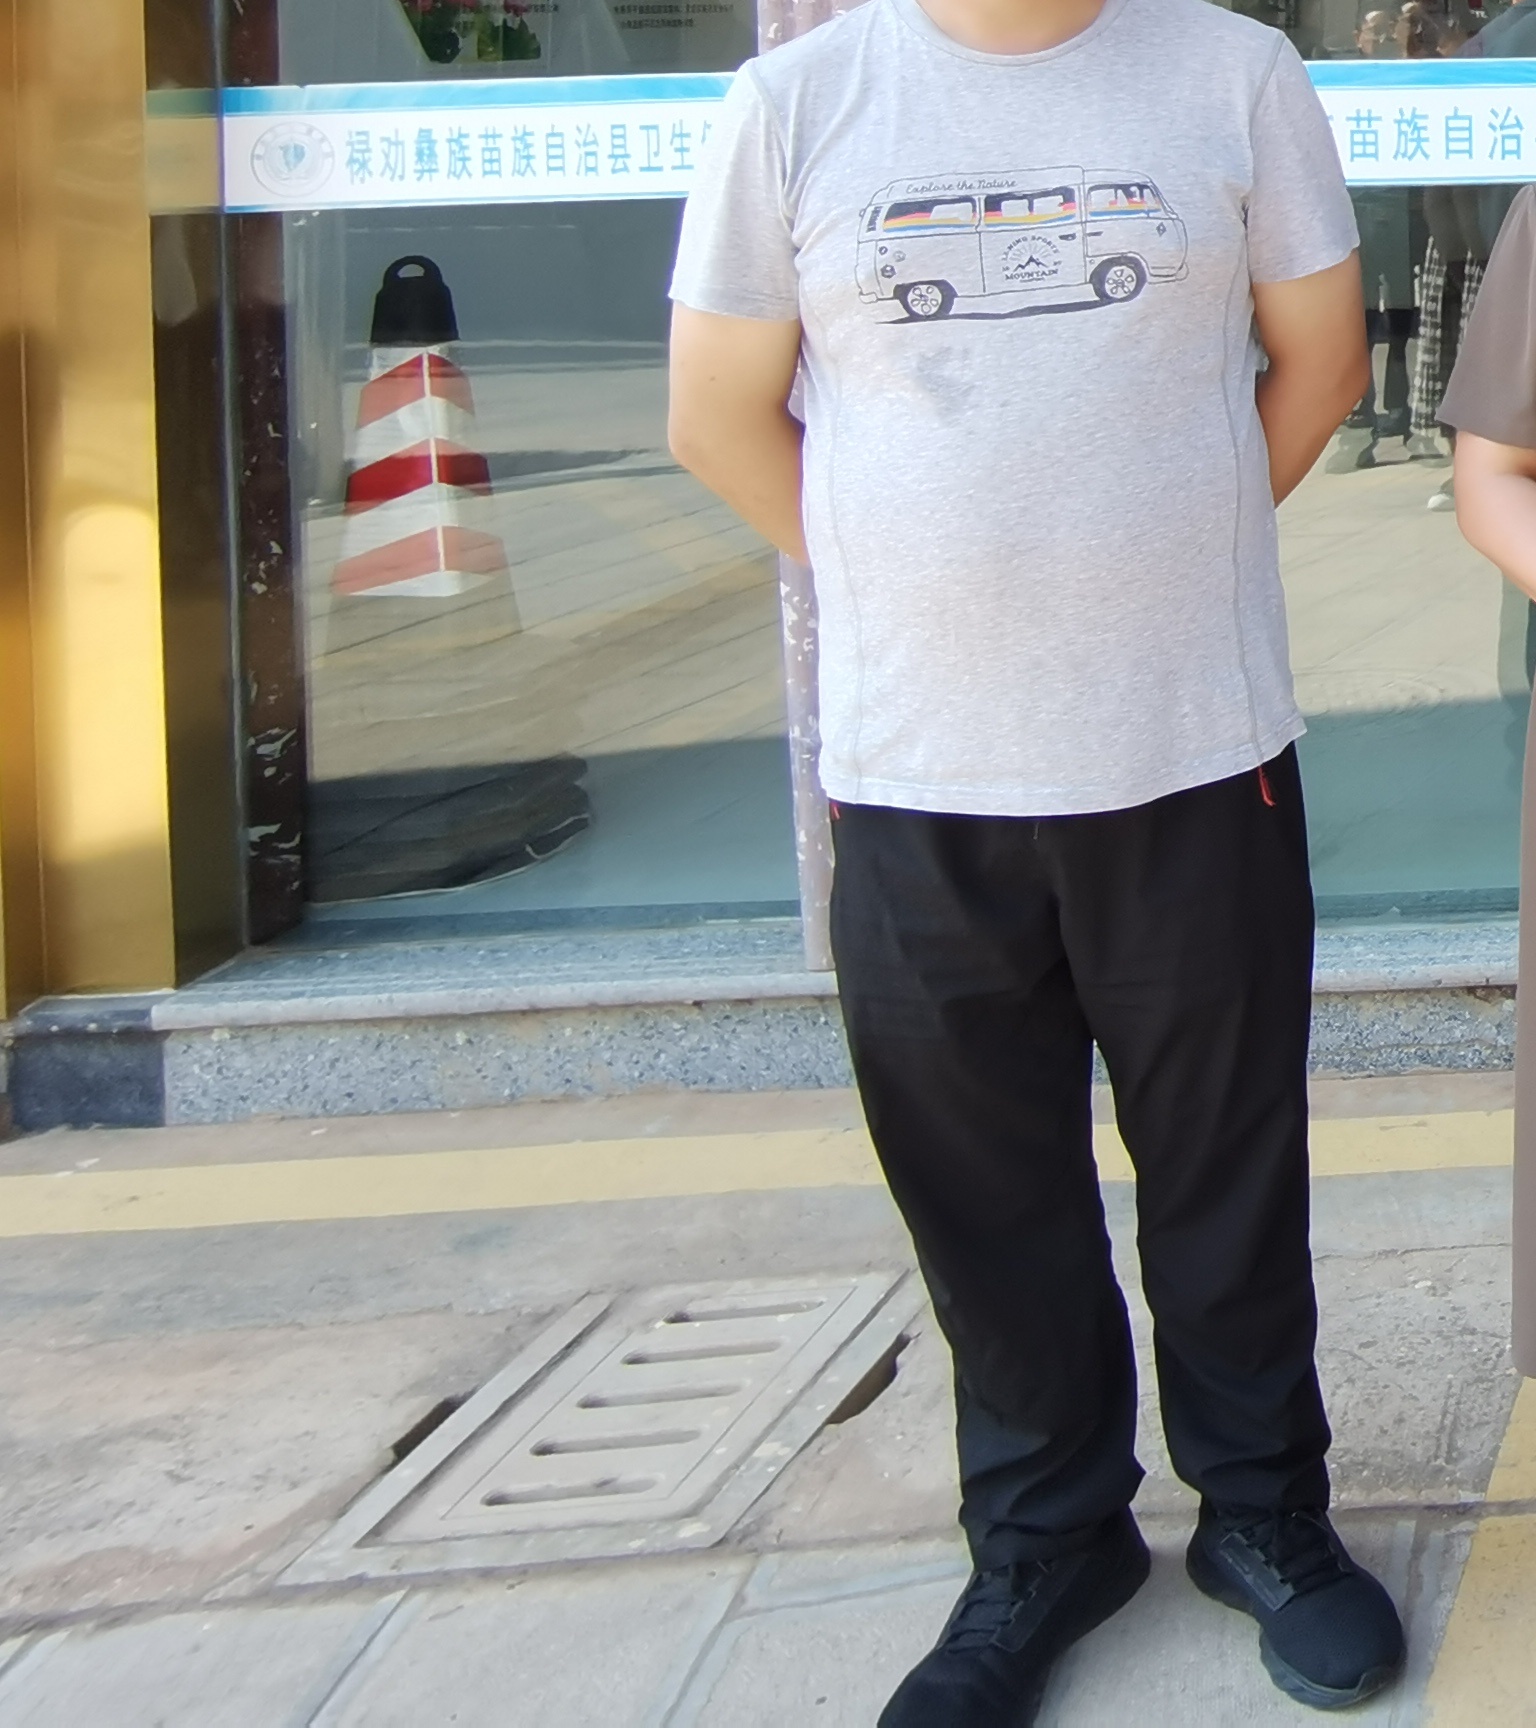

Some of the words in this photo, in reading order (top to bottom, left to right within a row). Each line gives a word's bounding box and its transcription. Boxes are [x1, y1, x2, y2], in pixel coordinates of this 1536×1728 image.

[345, 118, 713, 185] 禄劝彝族苗族自治县卫生
[905, 183, 955, 195] Explore
[957, 181, 974, 190] the
[976, 179, 1018, 190] Nature
[1005, 268, 1059, 281] MOUNTAIN
